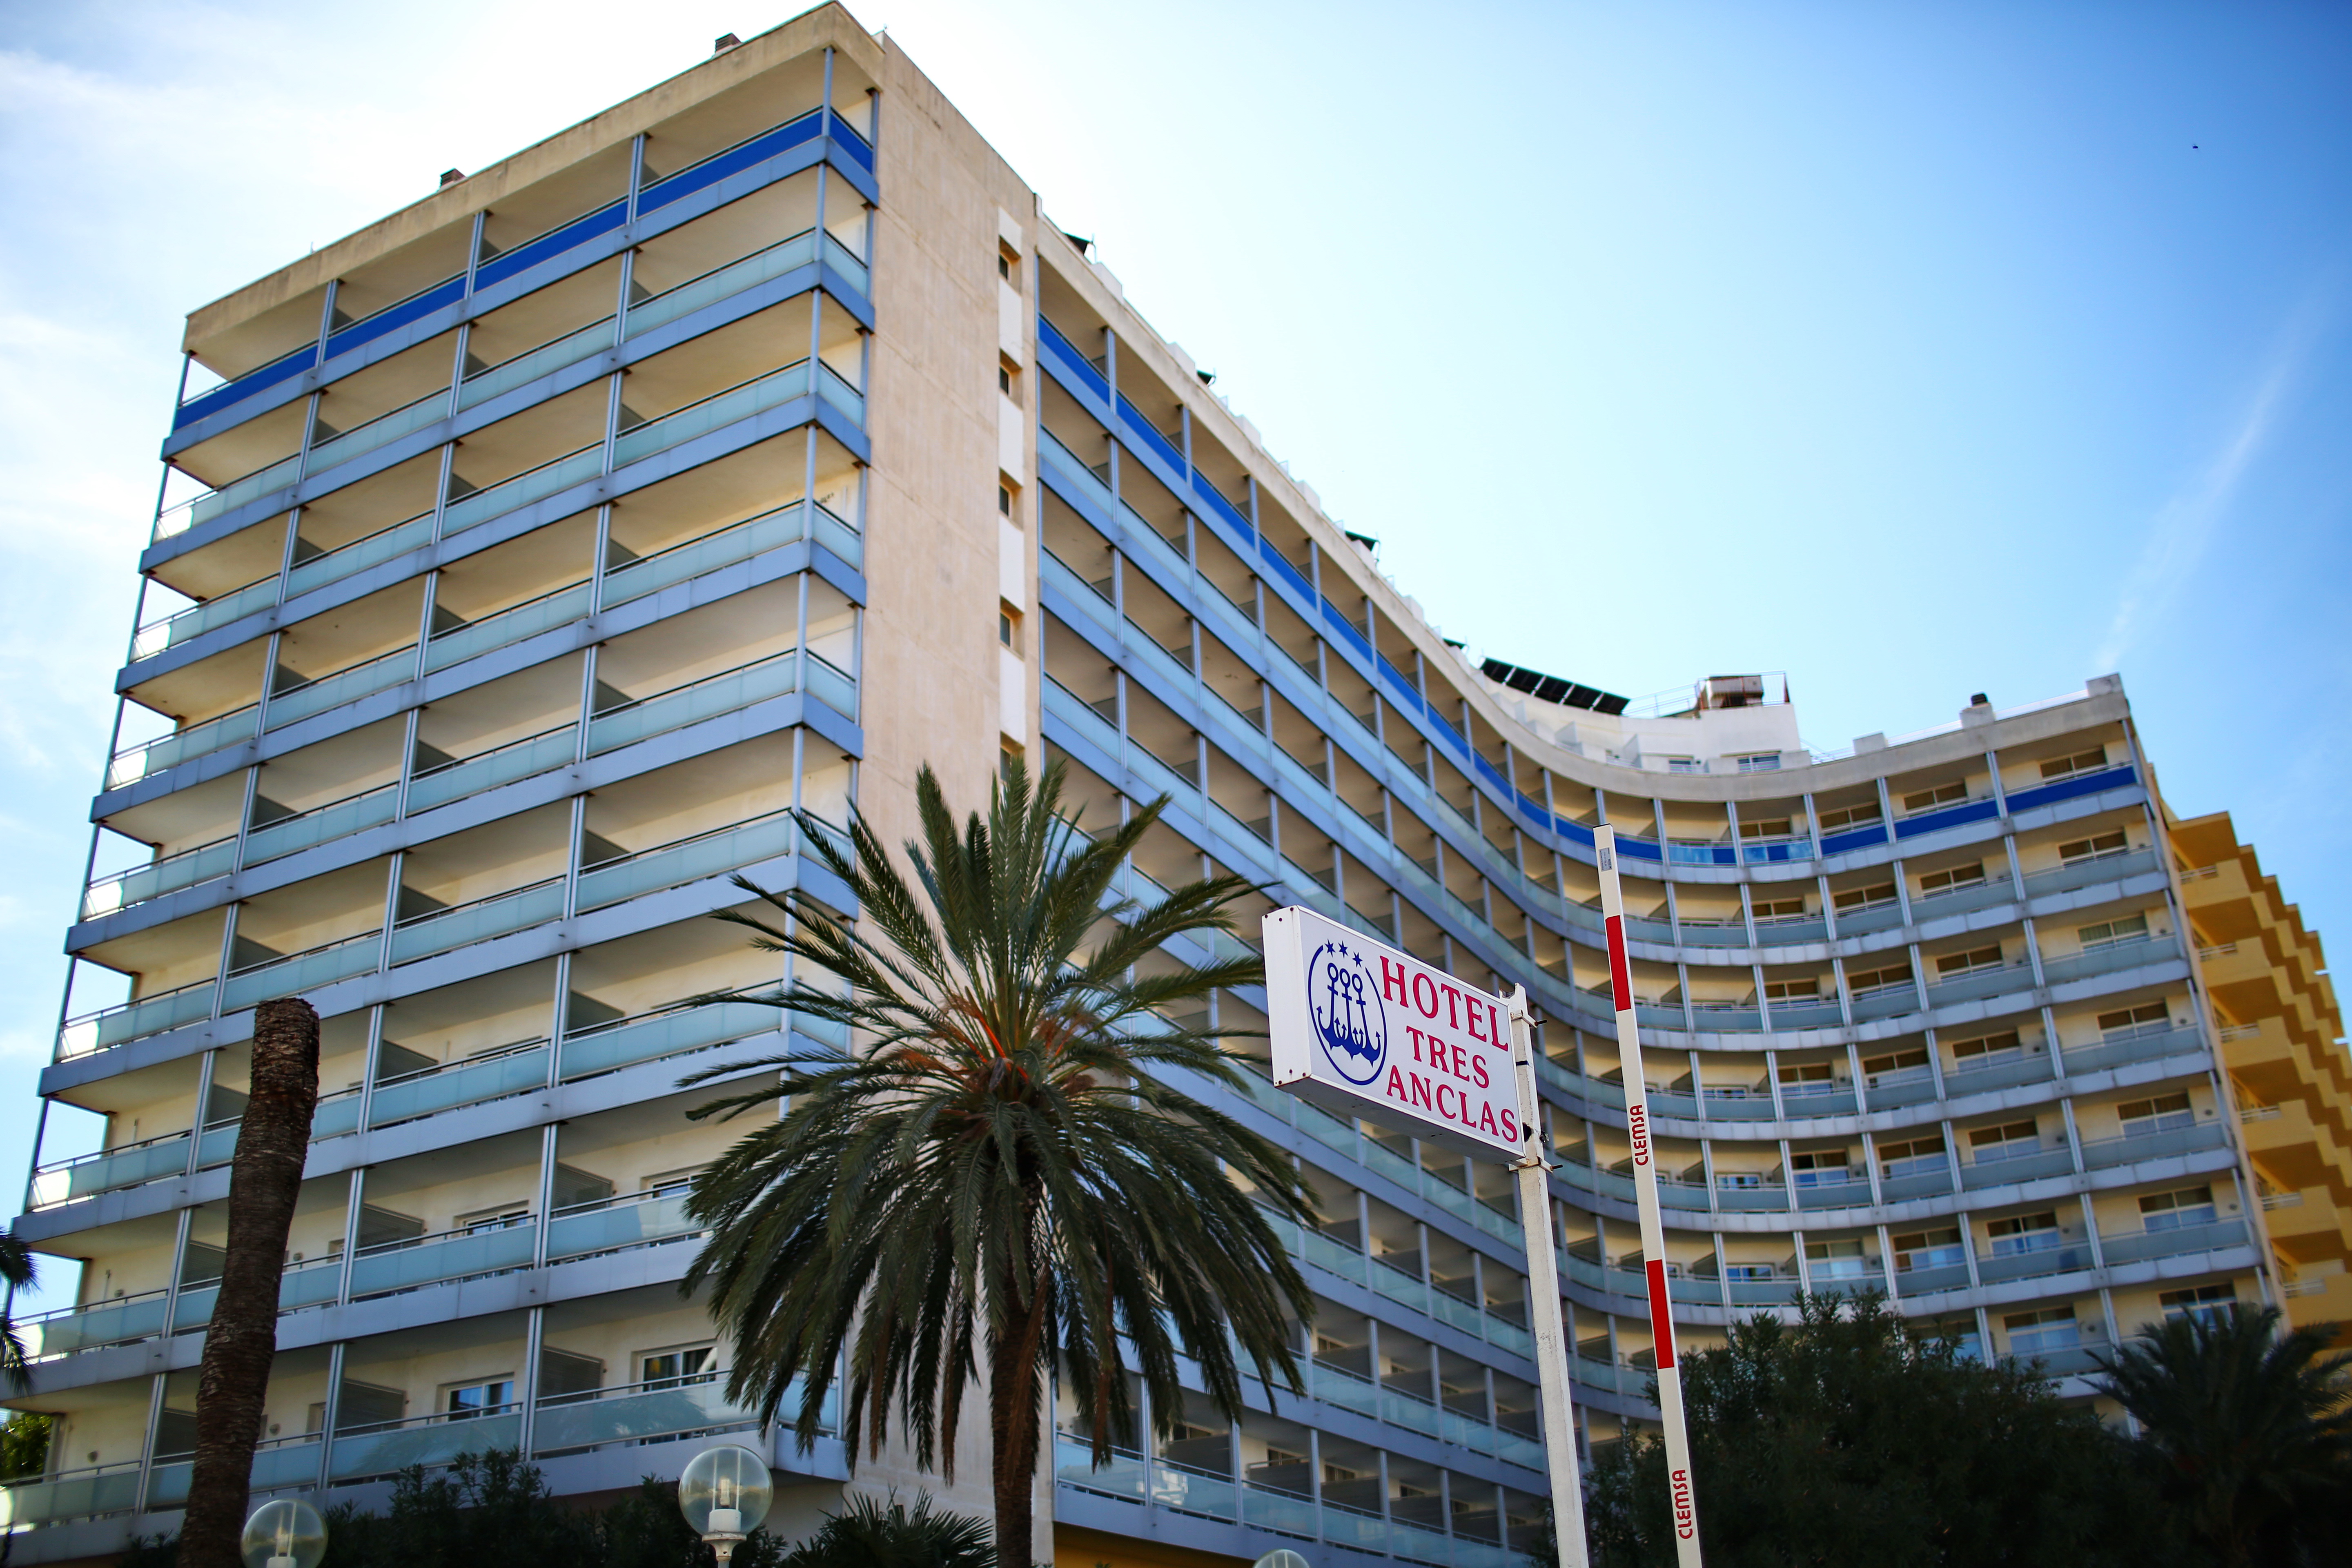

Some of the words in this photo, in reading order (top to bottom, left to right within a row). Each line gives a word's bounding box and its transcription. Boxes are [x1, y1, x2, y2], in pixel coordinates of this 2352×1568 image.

[1379, 956, 1508, 1051] HOTEL
[1406, 1026, 1490, 1089] TRES
[1386, 1065, 1518, 1143] ANCLAS
[1630, 1105, 1649, 1166] CLEMSA
[1672, 1470, 1693, 1539] CLEMSA
